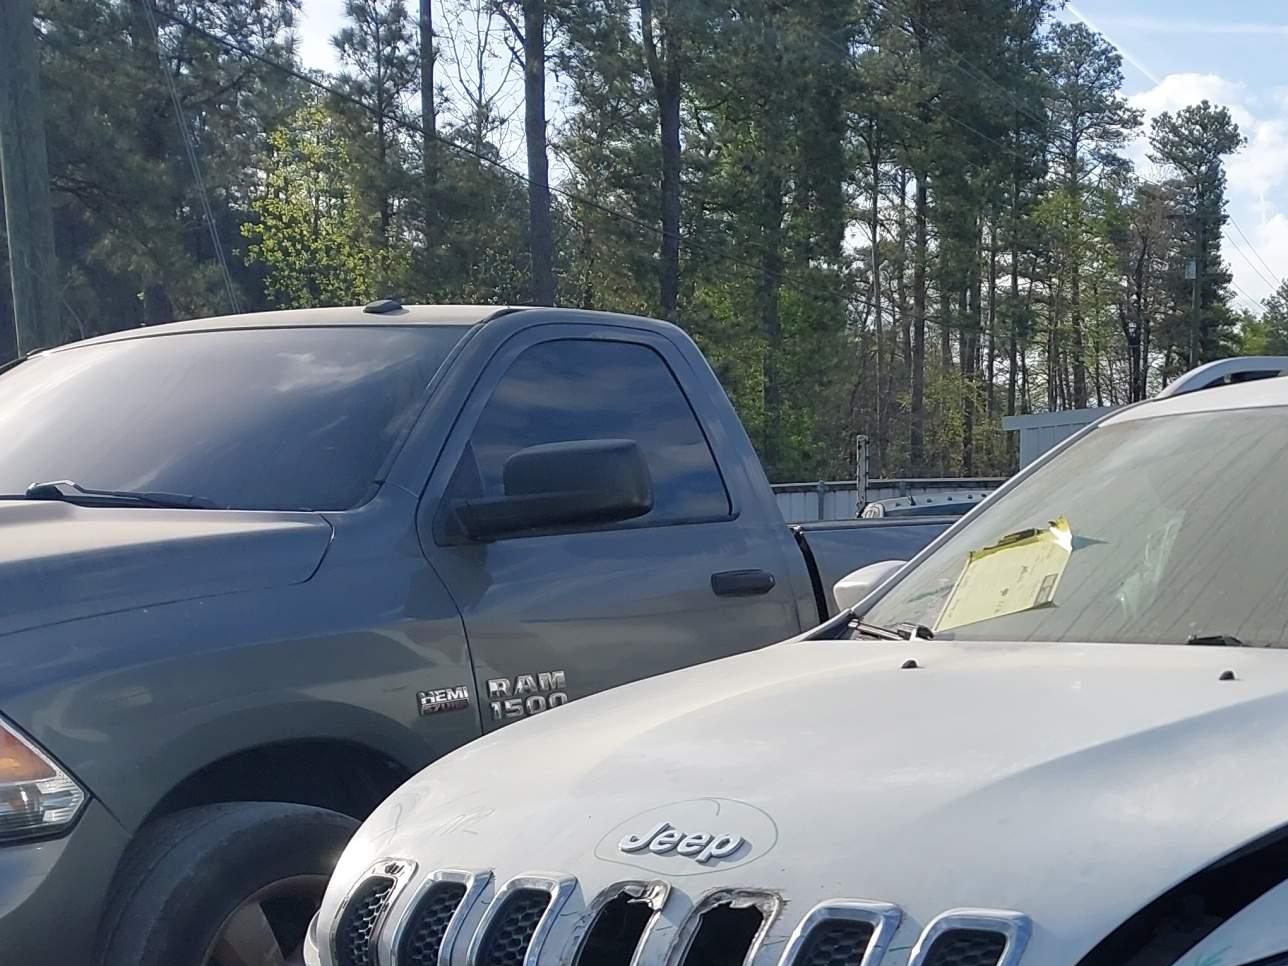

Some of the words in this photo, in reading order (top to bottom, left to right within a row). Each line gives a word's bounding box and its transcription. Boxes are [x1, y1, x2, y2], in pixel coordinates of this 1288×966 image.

[419, 686, 469, 705] HEMI
[487, 670, 567, 698] RAM
[489, 692, 568, 720] 1500
[618, 821, 747, 865] Jeep
